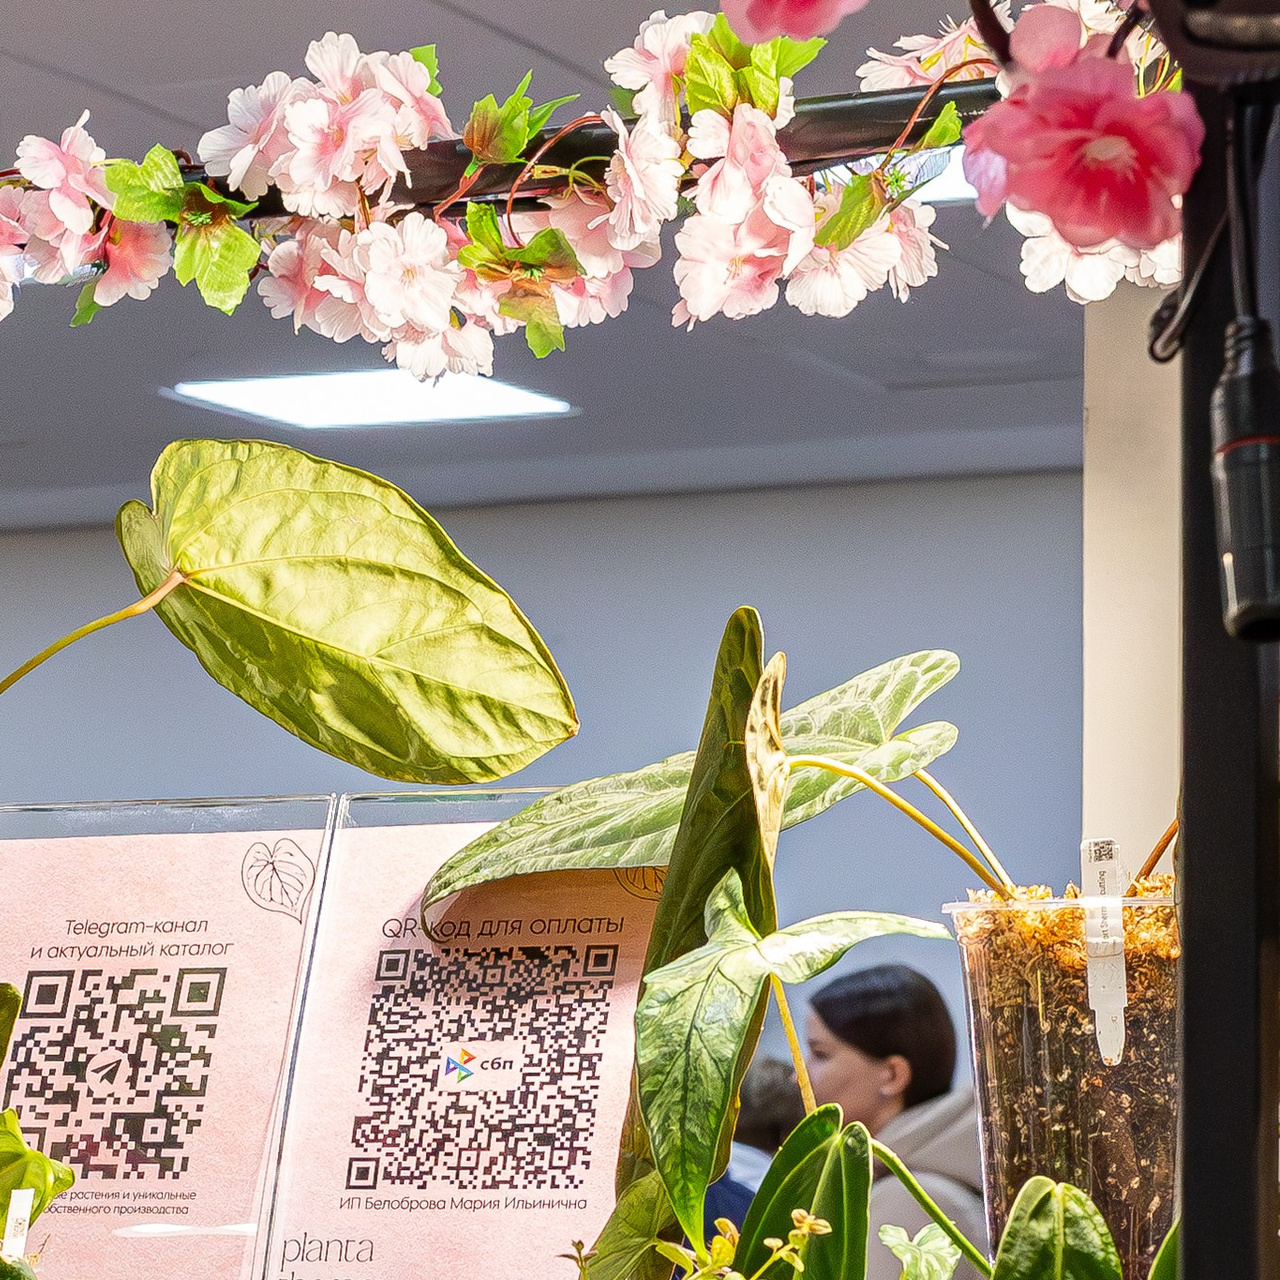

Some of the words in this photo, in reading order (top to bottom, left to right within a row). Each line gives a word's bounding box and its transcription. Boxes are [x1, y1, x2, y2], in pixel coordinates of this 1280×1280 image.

[1098, 870, 1107, 895] cutting
[65, 919, 209, 938] Telegram-канал
[477, 919, 522, 938] для
[530, 917, 625, 936] оплаты
[30, 946, 42, 959] и
[47, 942, 156, 961] актуальный
[159, 942, 234, 958] каталог
[480, 1056, 514, 1071] сбп
[70, 1191, 120, 1205] растения
[122, 1191, 131, 1200] и
[132, 1190, 197, 1202] уникальные
[339, 1197, 361, 1210] ИП
[364, 1196, 447, 1212] Белоброва
[450, 1197, 500, 1212] Мария
[503, 1197, 588, 1210] Ильинична
[42, 1202, 111, 1215] обственного
[113, 1204, 189, 1216] производства
[281, 1232, 375, 1272] planta
